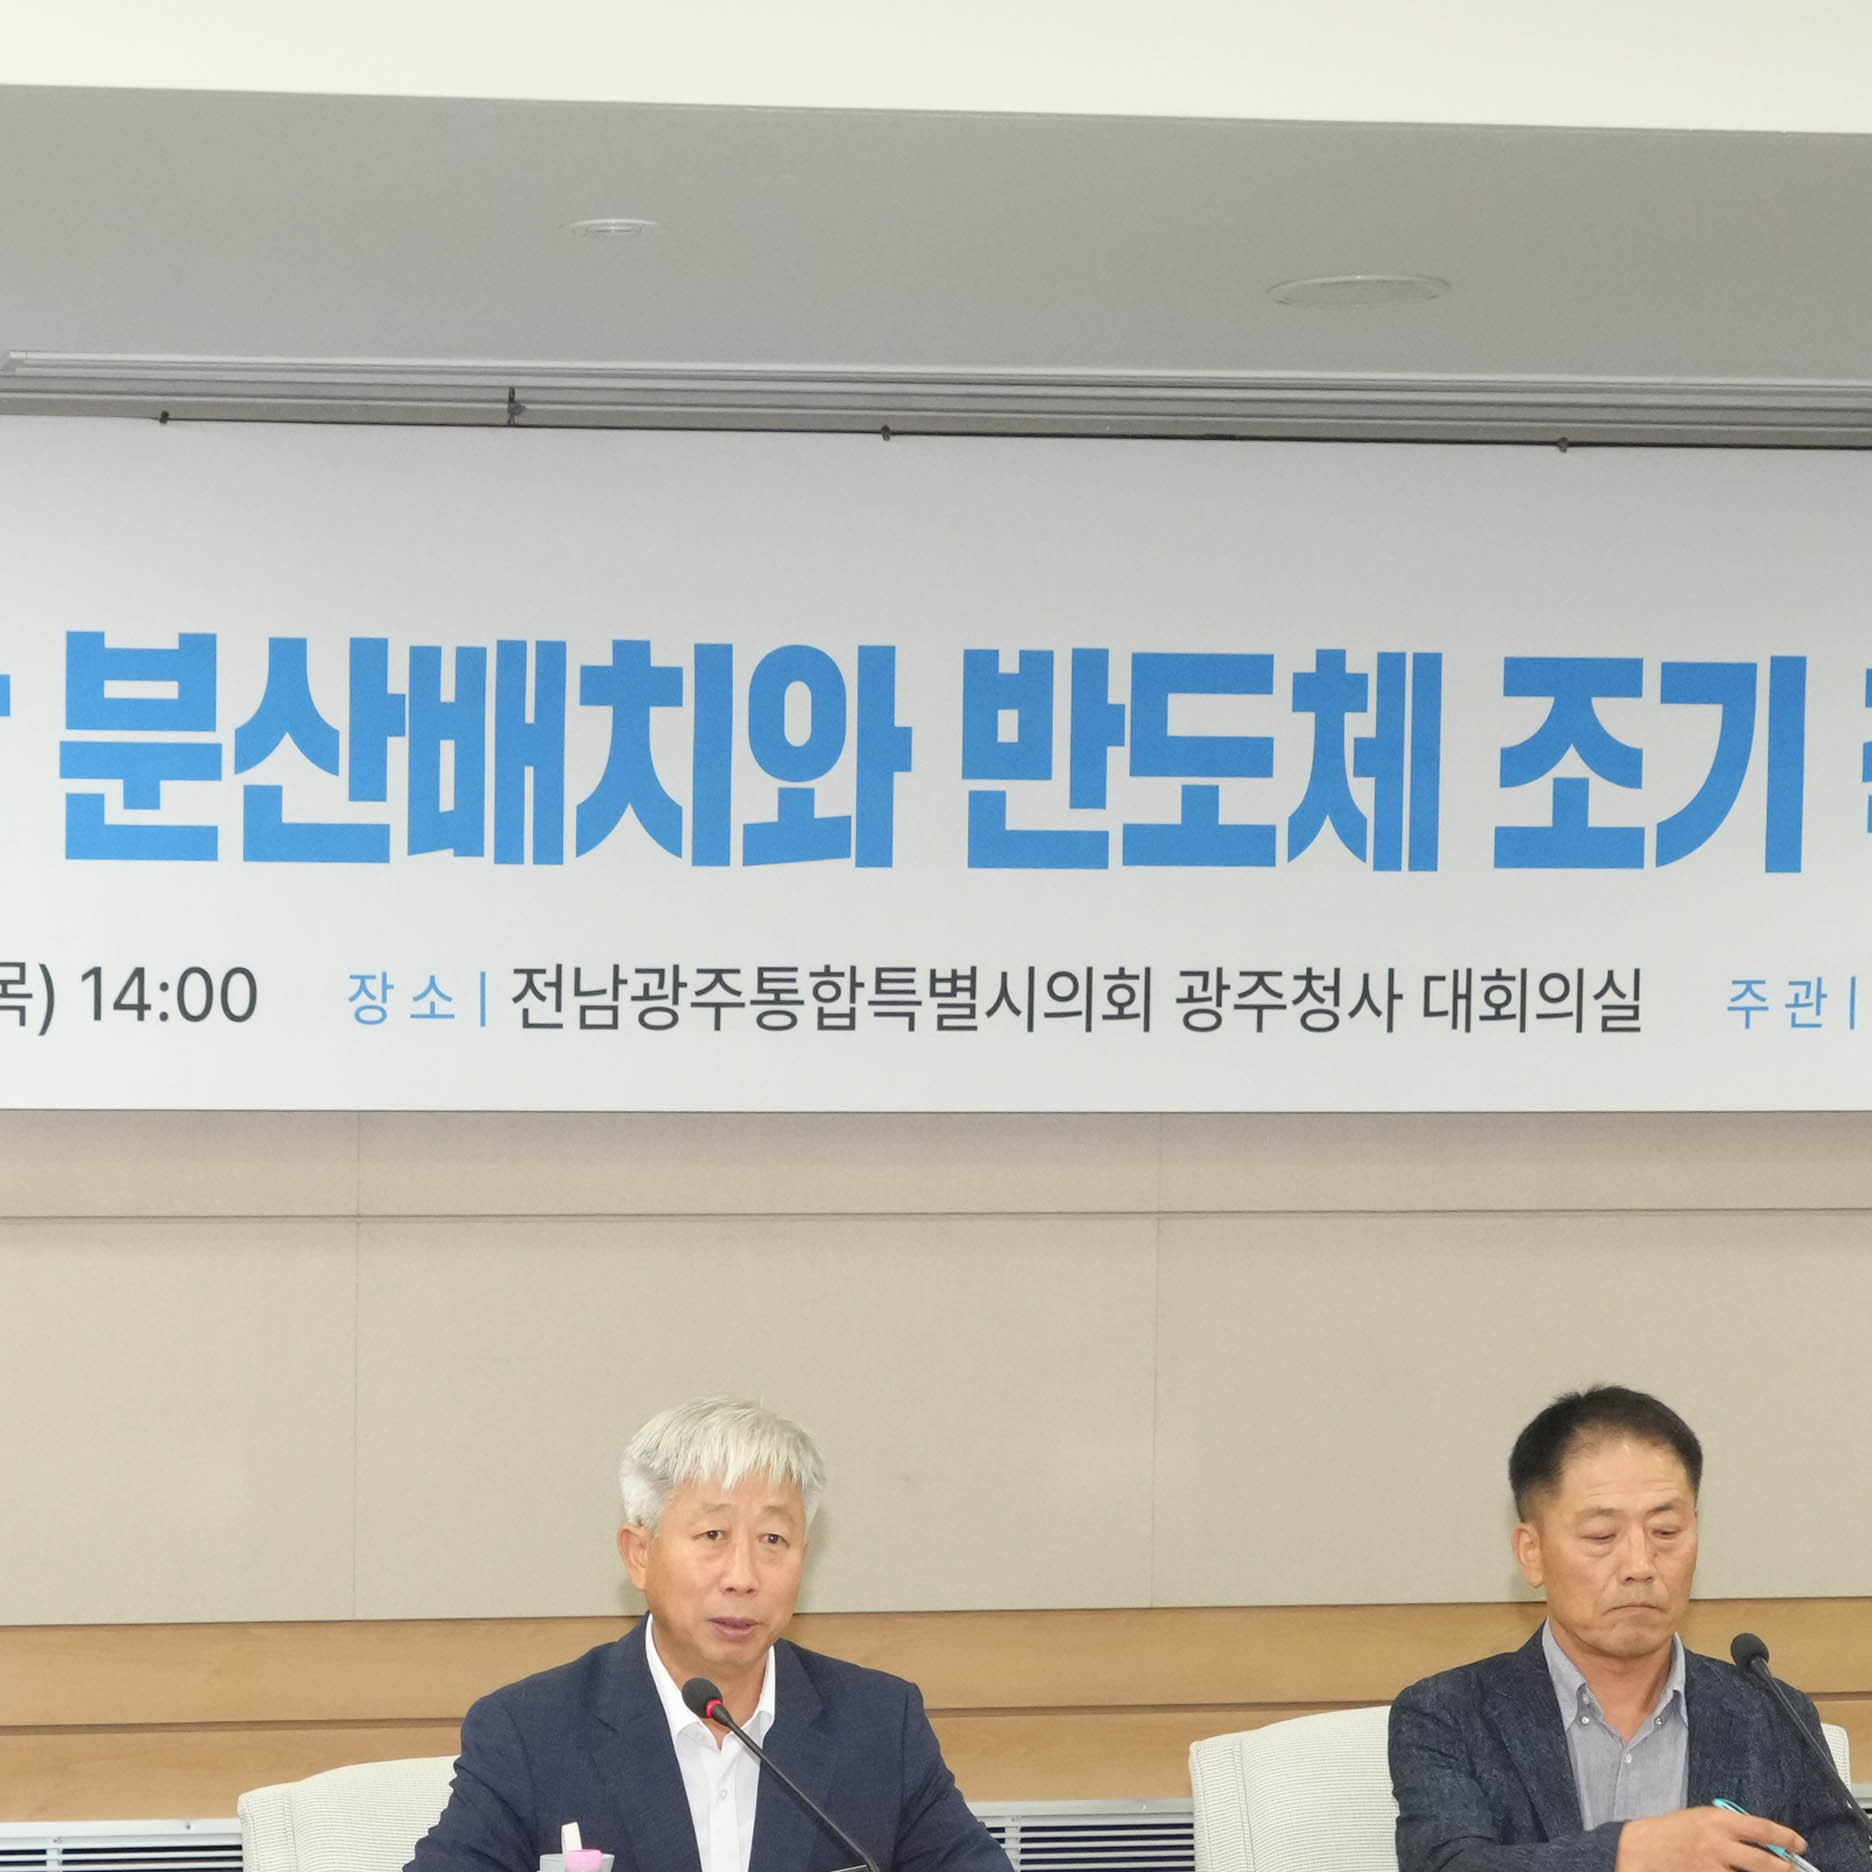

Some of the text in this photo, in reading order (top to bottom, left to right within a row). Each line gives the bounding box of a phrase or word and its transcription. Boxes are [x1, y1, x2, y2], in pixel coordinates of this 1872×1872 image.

[60, 631, 914, 869] 분산배치와
[961, 647, 1444, 873] 반도체
[1493, 655, 1809, 874] 조기
[81, 966, 260, 1025] 14:00
[511, 963, 1154, 1034] 전남광주통합특별시의회
[1175, 966, 1406, 1035] 광주청사
[1423, 967, 1643, 1035] 대회의실
